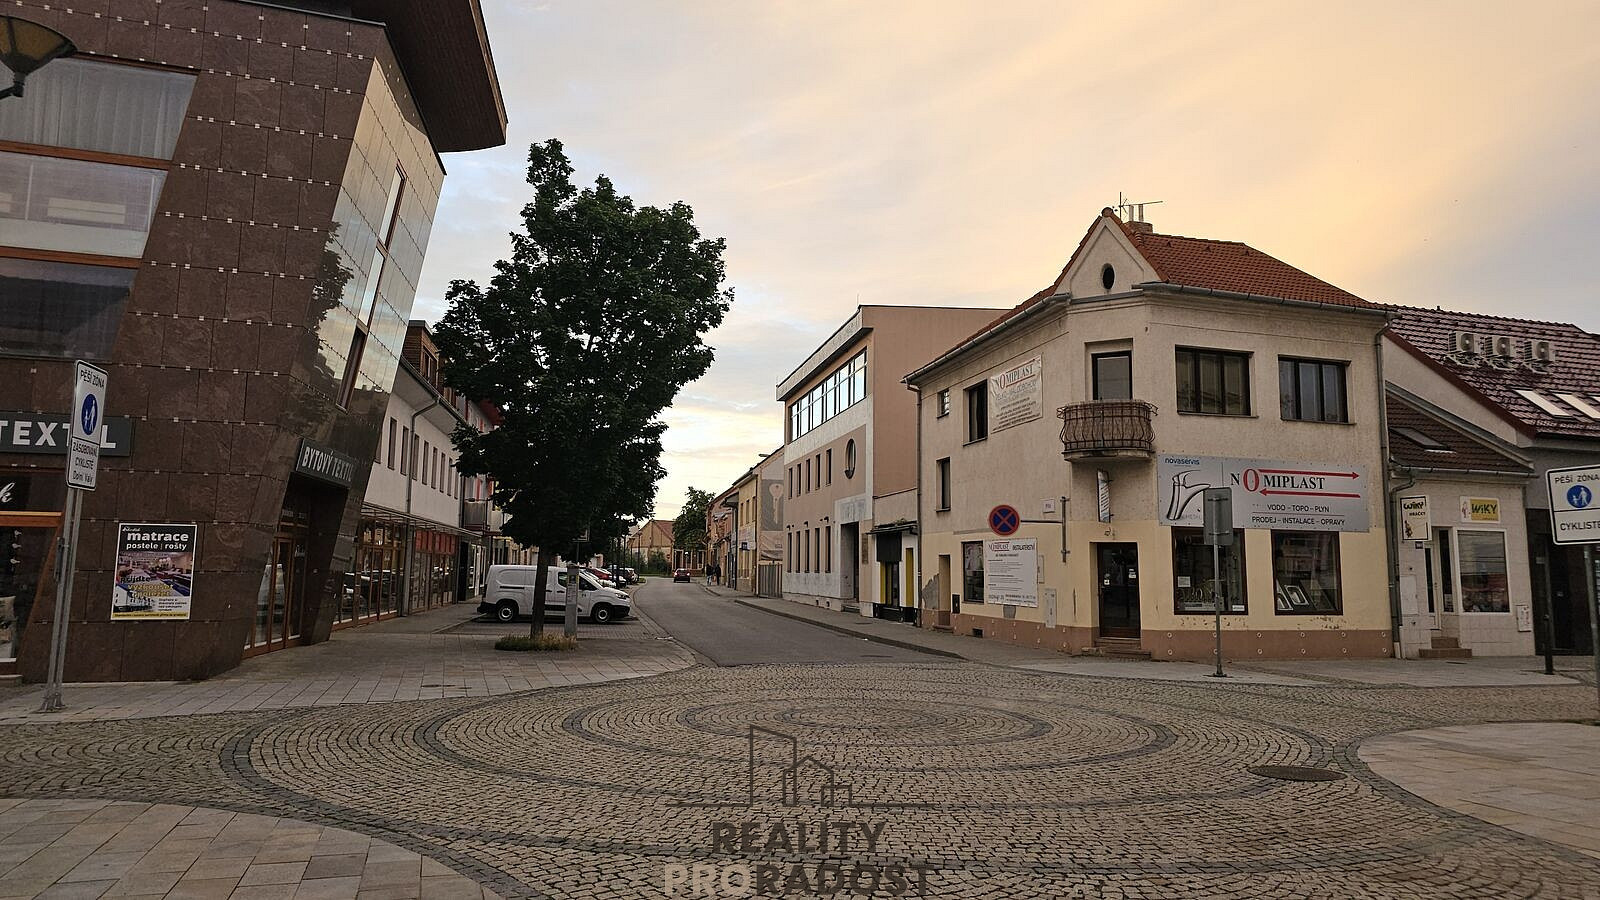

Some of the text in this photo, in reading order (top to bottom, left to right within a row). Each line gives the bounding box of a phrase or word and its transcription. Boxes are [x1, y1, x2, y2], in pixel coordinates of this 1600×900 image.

[995, 364, 1034, 389] NOMIPLAST
[302, 446, 354, 482] BYTOVÝ TEXTIL
[1267, 503, 1286, 511] VODO
[1292, 504, 1309, 512] TOPO
[1314, 505, 1330, 513] PLYN
[1251, 516, 1277, 524] PRODEJ
[1282, 517, 1316, 525] INSTALACE
[1320, 518, 1346, 526] OPRAVY
[127, 531, 189, 542] matrace
[126, 542, 187, 551] postele rošty
